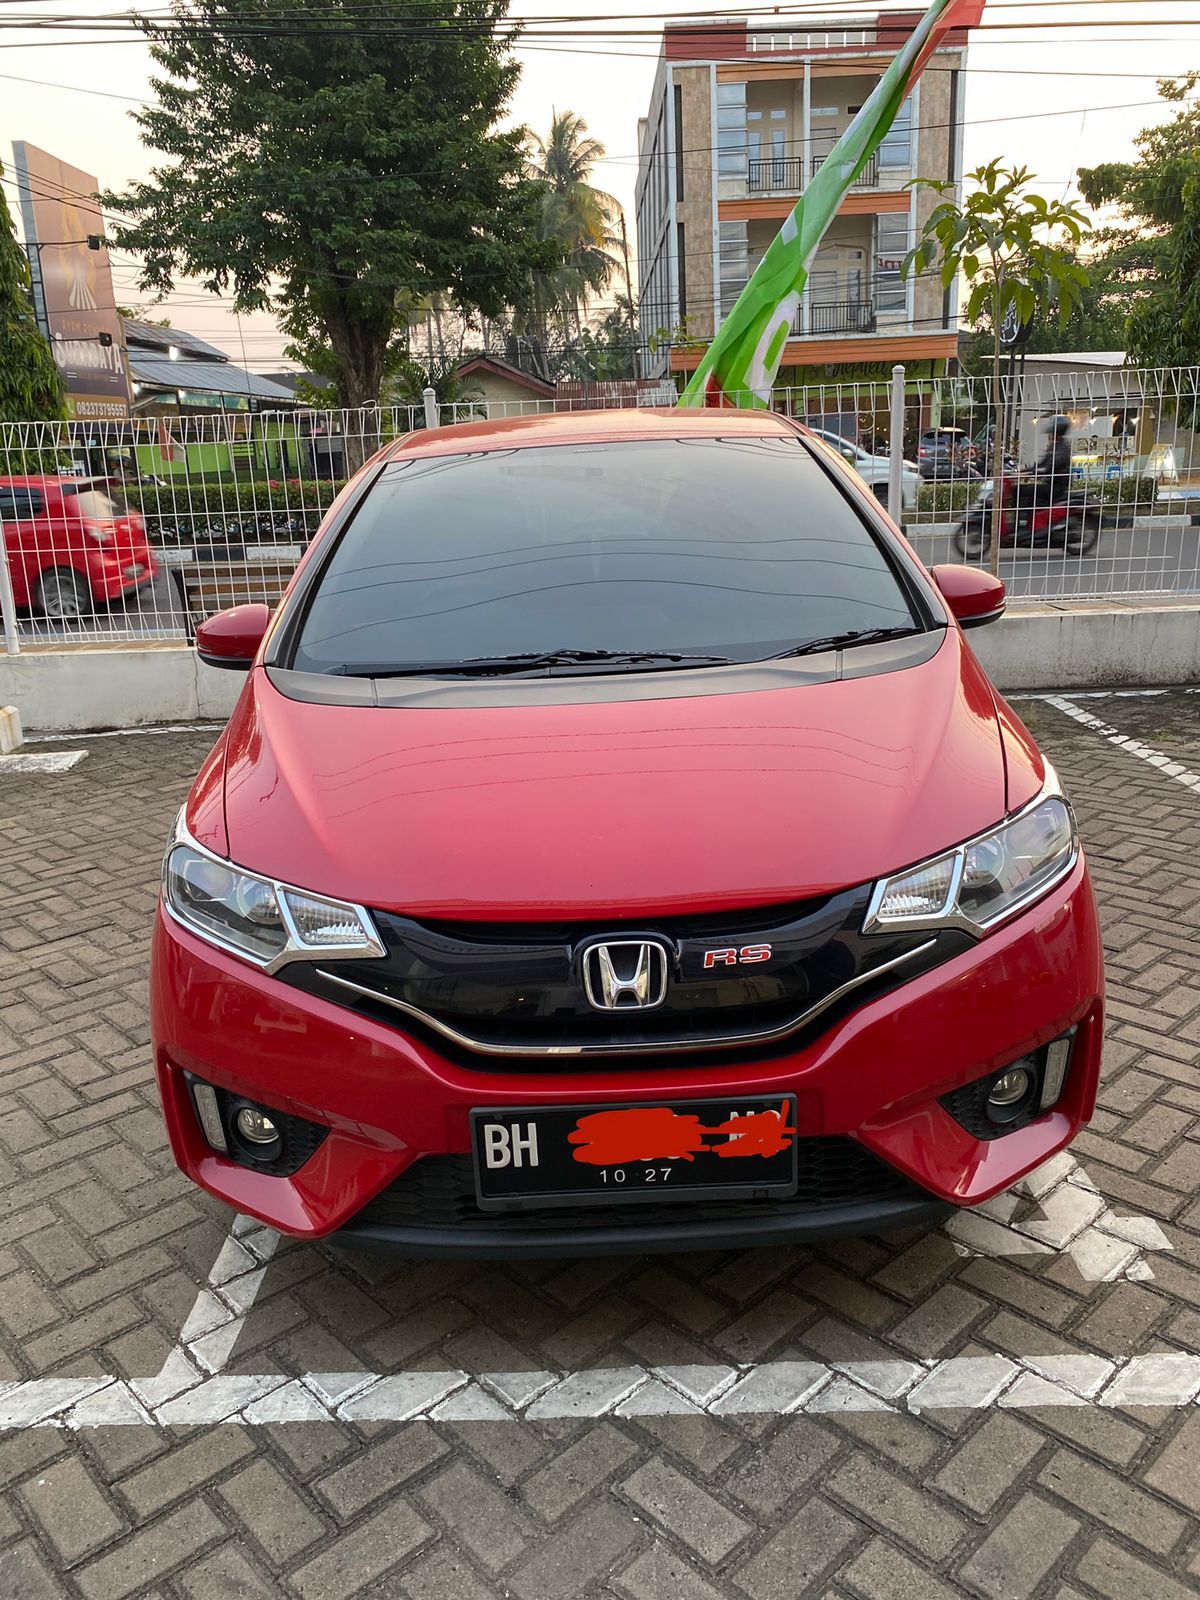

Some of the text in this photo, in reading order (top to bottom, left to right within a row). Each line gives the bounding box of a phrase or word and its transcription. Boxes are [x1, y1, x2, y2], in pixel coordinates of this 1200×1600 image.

[76, 401, 127, 417] 082373795557
[703, 944, 772, 968] RS
[484, 1122, 540, 1169] BH
[600, 1167, 672, 1183] 10 27
